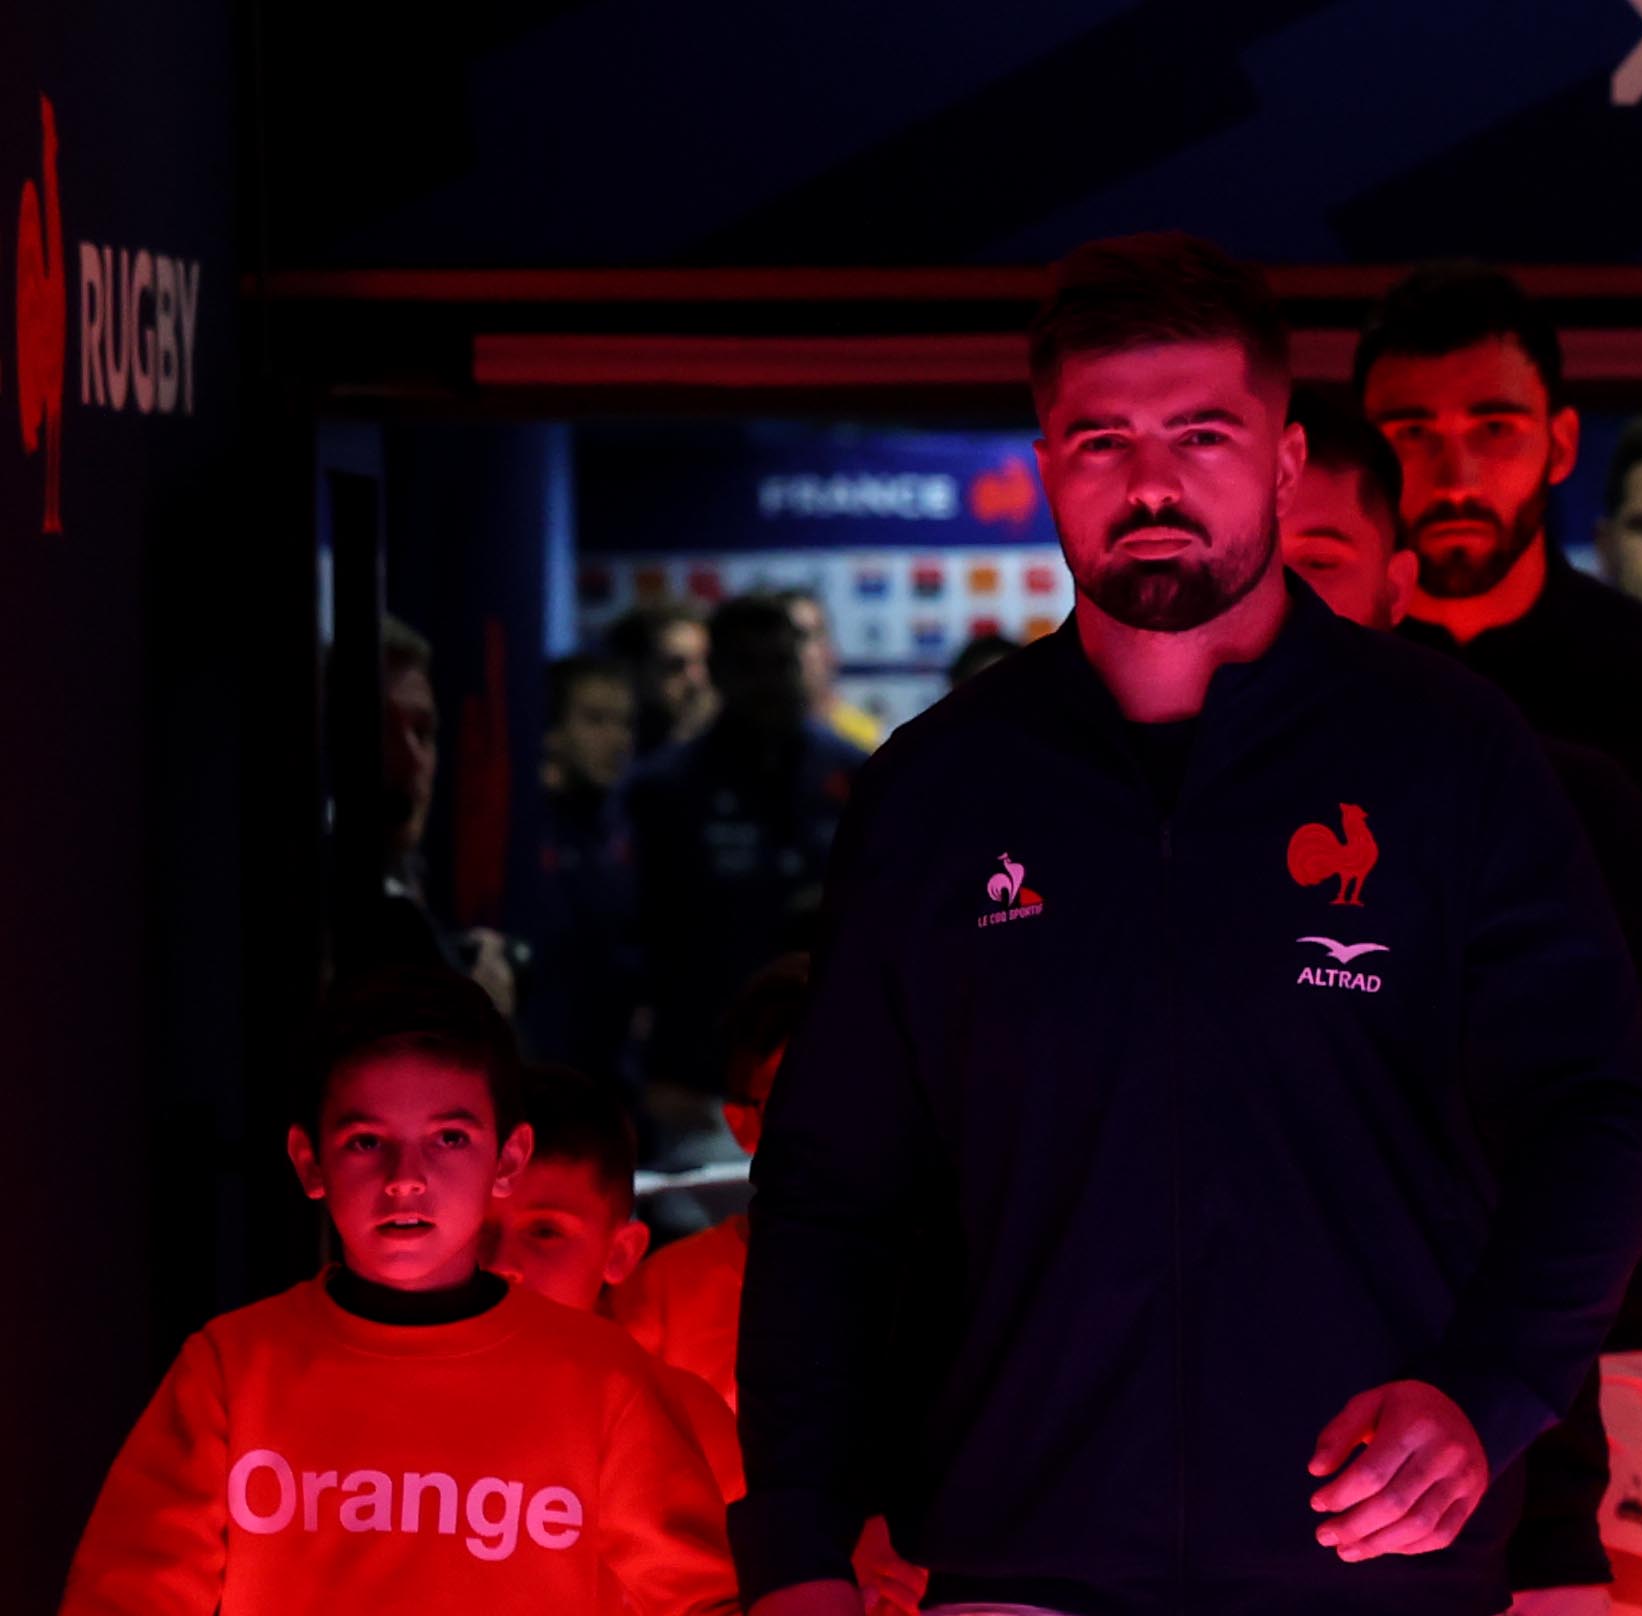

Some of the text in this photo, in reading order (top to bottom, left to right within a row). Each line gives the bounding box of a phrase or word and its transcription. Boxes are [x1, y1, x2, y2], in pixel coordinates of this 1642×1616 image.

[79, 241, 199, 416] RUGBY
[1297, 967, 1381, 992] ALTRAD
[228, 1449, 583, 1561] Orange
